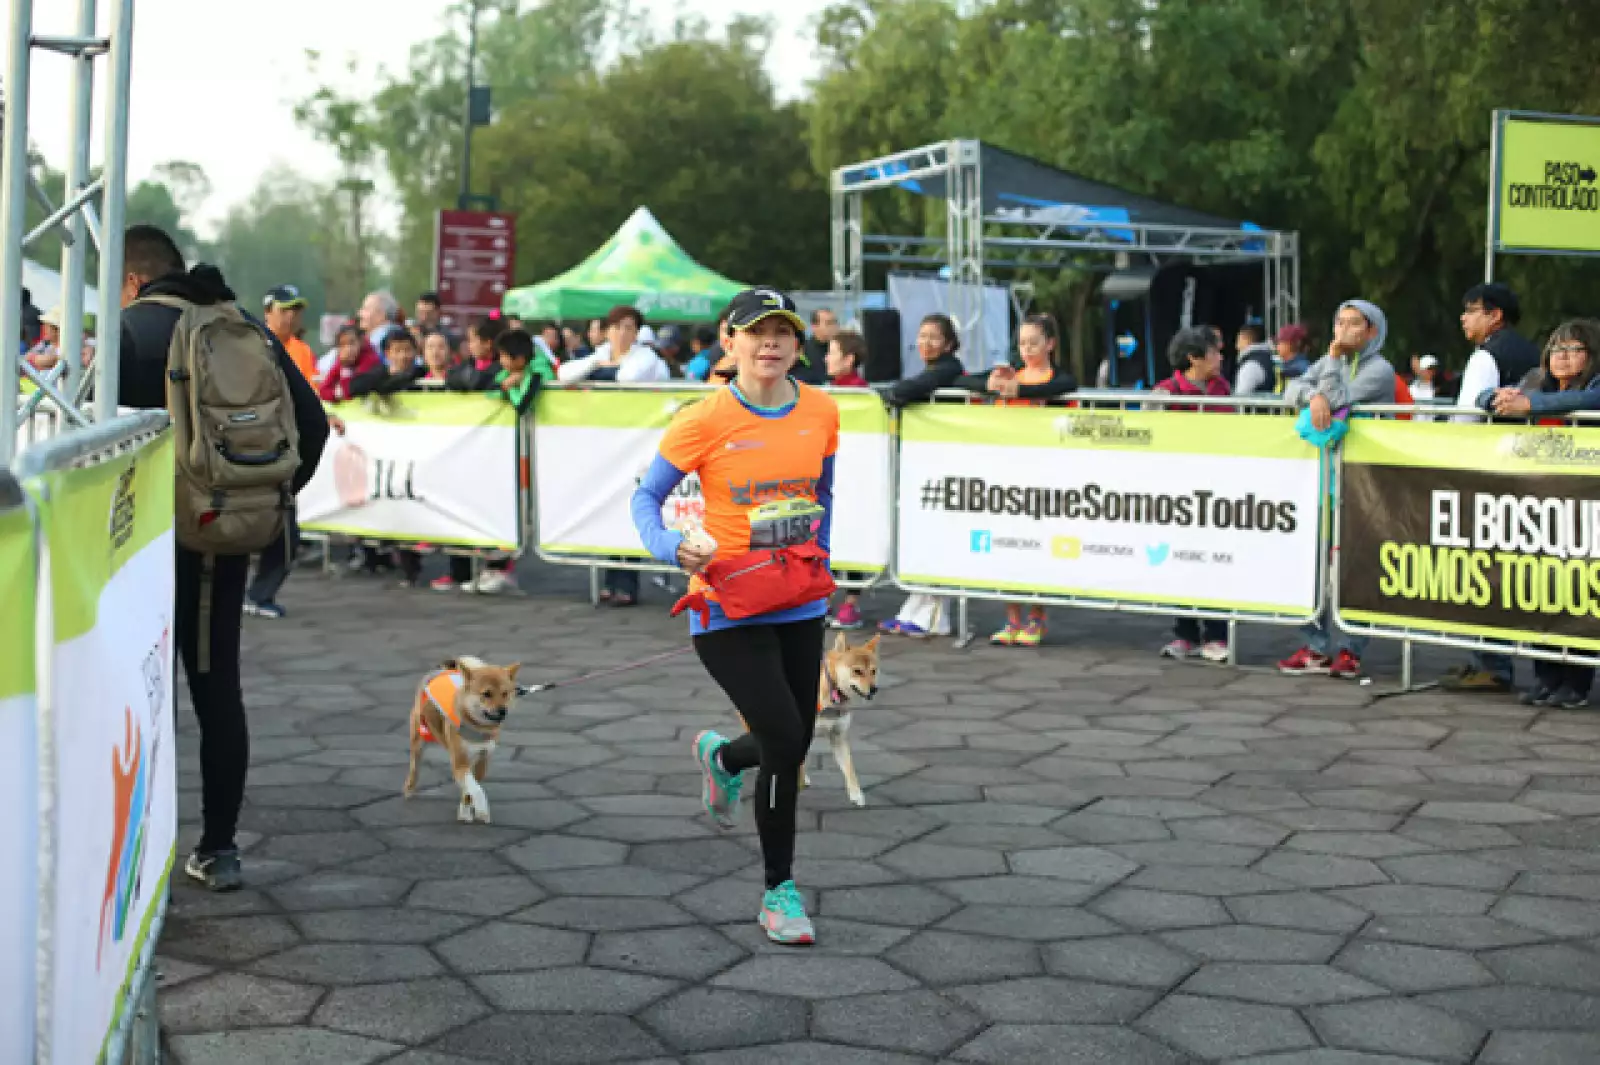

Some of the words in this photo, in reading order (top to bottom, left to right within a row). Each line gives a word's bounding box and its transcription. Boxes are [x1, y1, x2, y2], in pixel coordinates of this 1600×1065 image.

[1509, 184, 1598, 210] CONTROLADO
[1545, 161, 1581, 184] PASO
[920, 476, 1298, 533] #ElBosqueSomosTodos
[1431, 490, 1470, 547] EL
[1379, 541, 1491, 608] SOMOS
